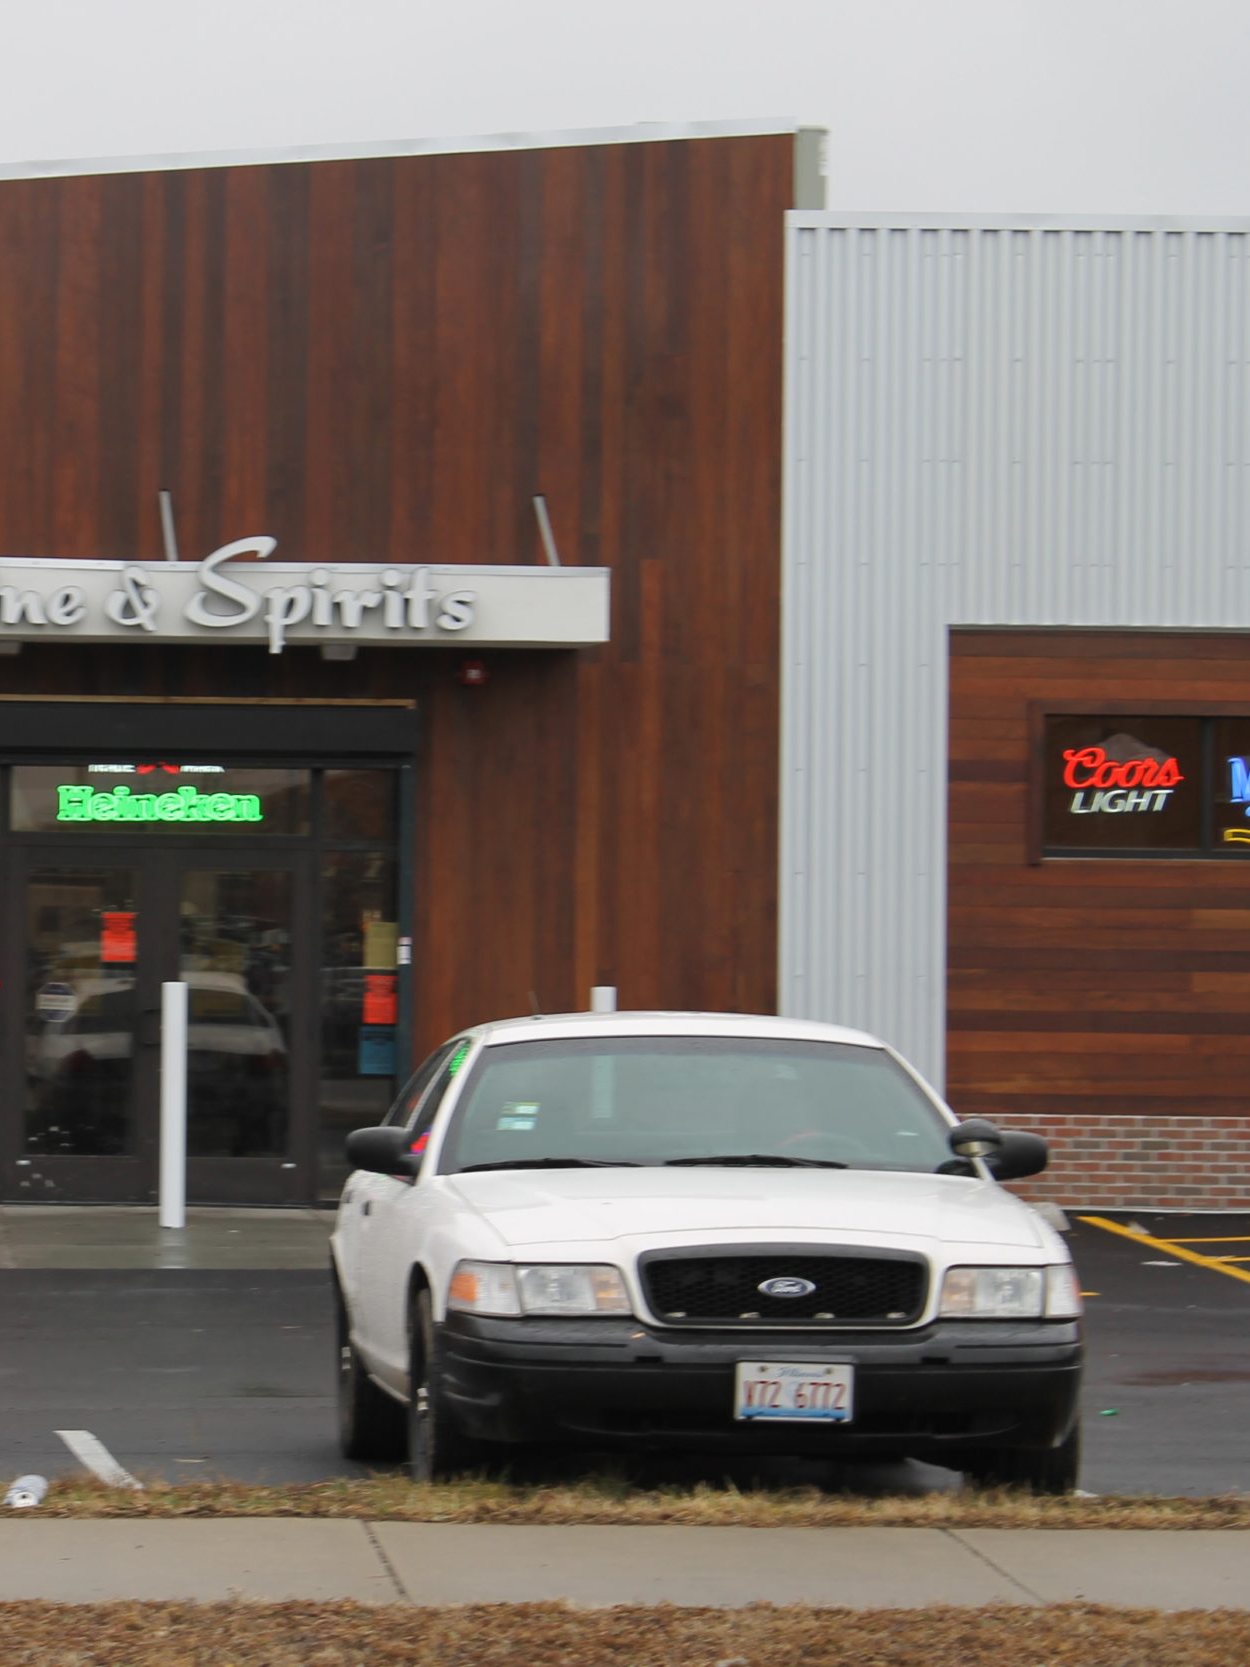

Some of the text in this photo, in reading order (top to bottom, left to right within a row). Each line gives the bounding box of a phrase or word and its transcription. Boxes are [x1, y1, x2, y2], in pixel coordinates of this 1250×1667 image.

[104, 566, 158, 632] &
[184, 535, 478, 654] Spirits
[1063, 747, 1184, 789] Coors
[56, 785, 264, 822] Heineken
[1070, 789, 1174, 814] LIGHT
[794, 1381, 846, 1411] 6772
